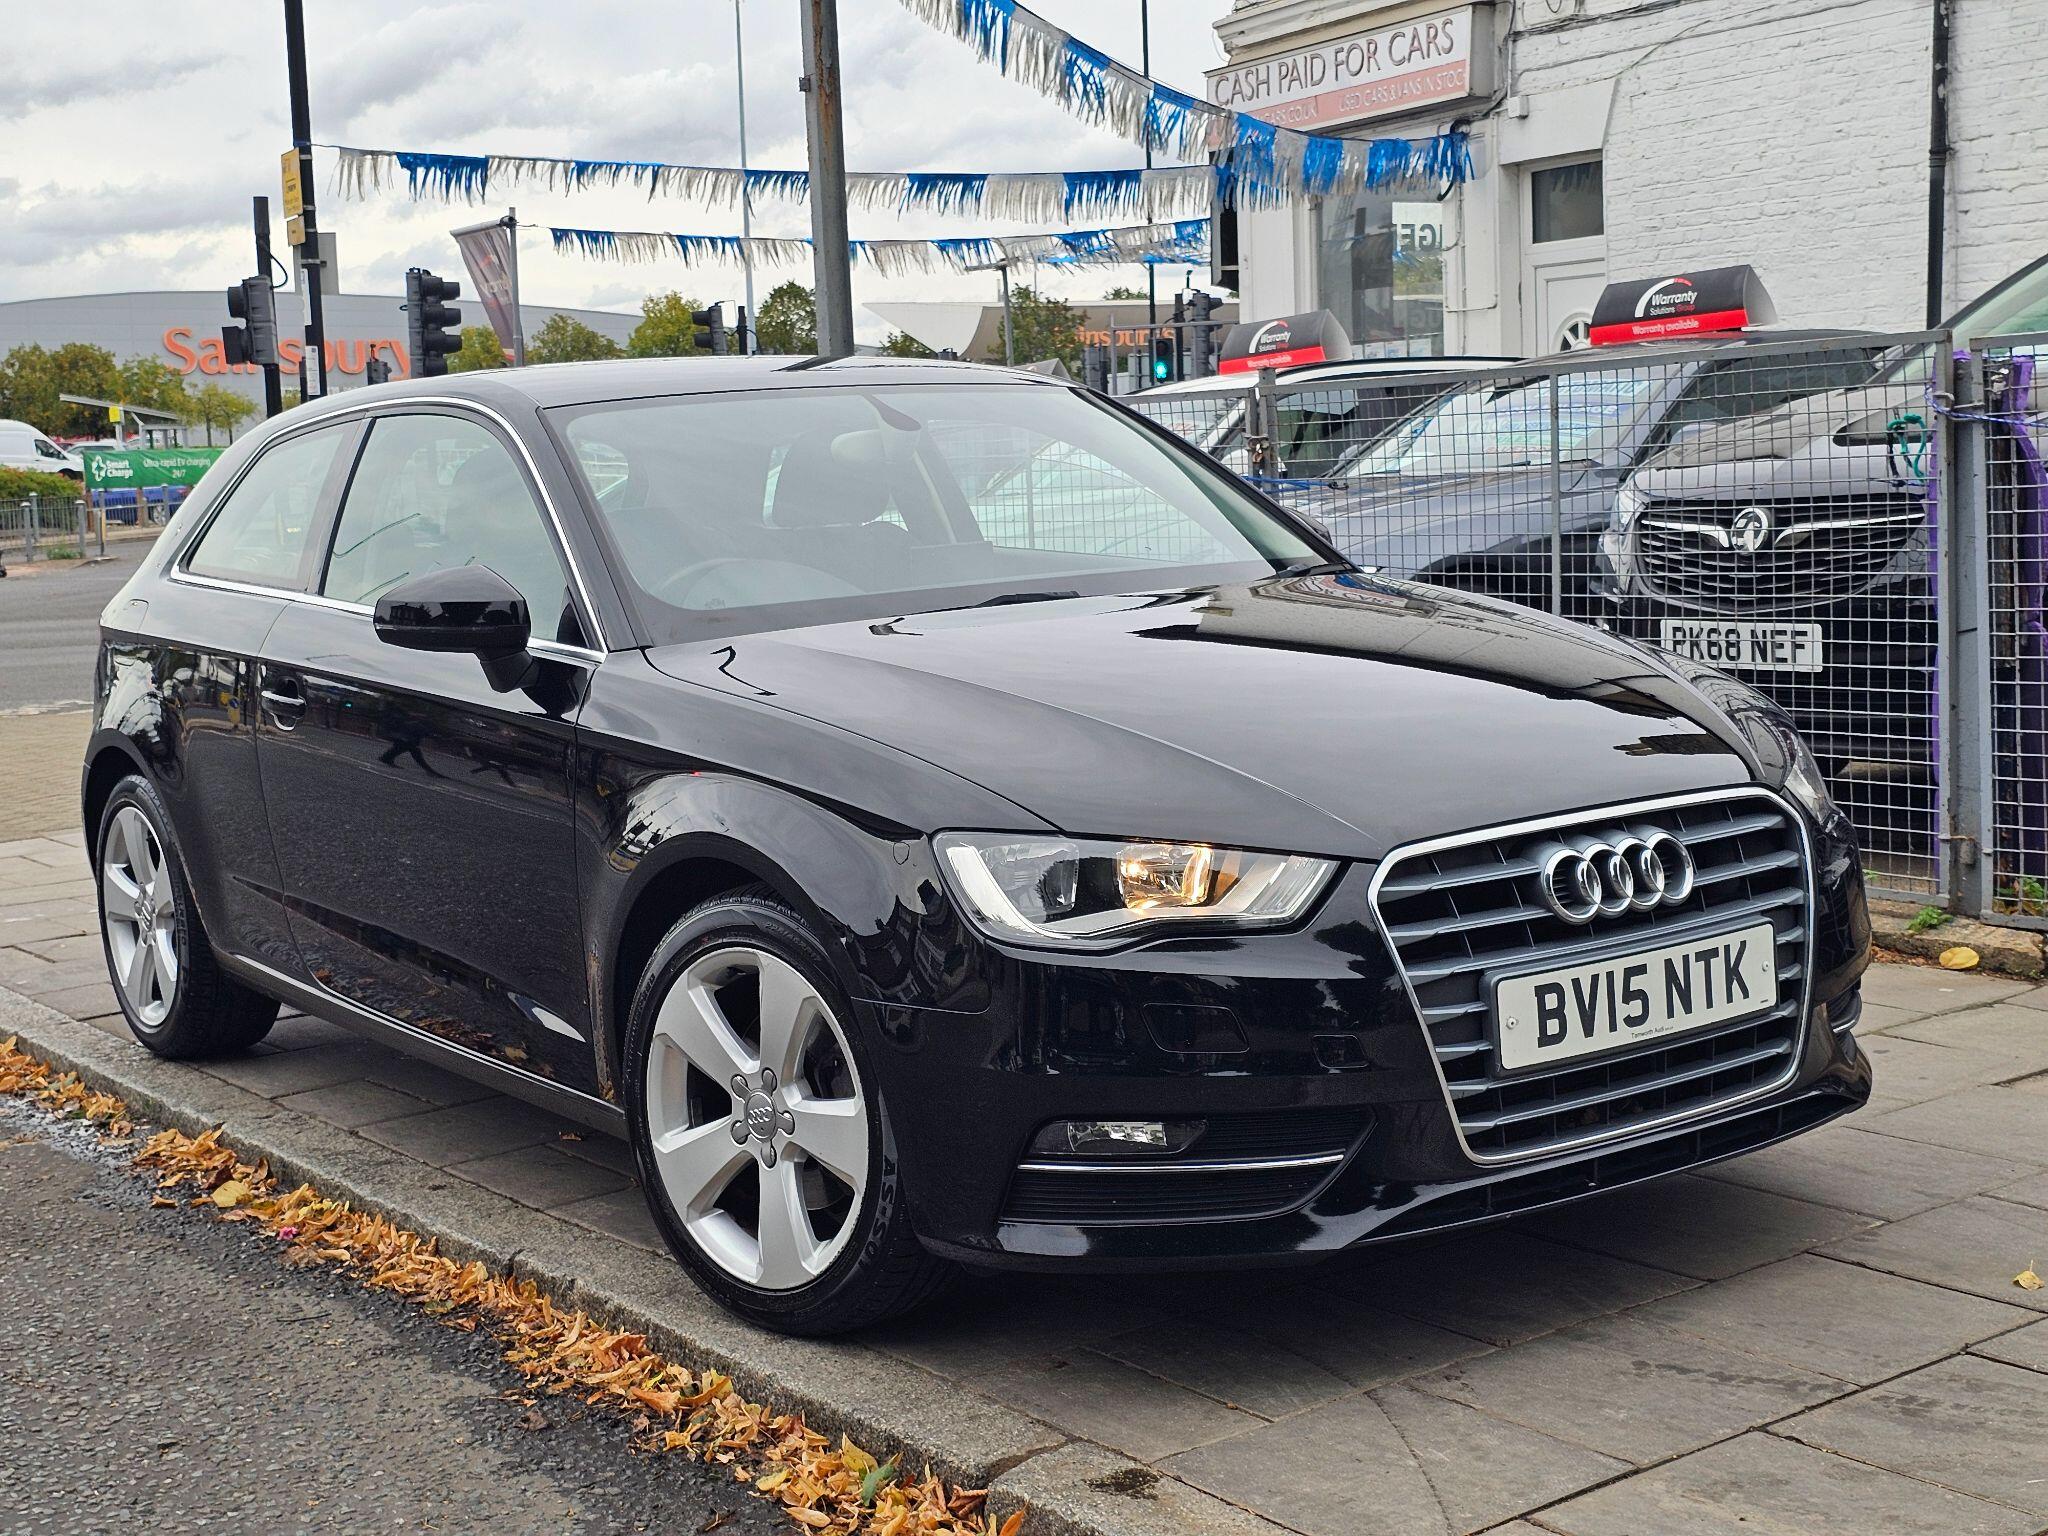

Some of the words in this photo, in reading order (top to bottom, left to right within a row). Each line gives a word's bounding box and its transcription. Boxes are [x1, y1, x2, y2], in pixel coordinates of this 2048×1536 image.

[1214, 64, 1271, 106] CASH
[1277, 53, 1327, 95] PAID
[1334, 38, 1381, 82] FOR
[1388, 17, 1454, 67] CARS
[1363, 86, 1387, 106] CARS
[1651, 290, 1698, 305] Warranty
[1650, 306, 1676, 317] Solutions
[1632, 323, 1665, 335] Warranty
[1665, 319, 1699, 331] available
[1260, 331, 1292, 344] Warranty
[106, 459, 130, 469] Smart
[106, 468, 134, 479] Charge
[1751, 629, 1808, 664] NEF
[1533, 962, 1651, 1049] BV15
[1664, 939, 1750, 1020] NTK
